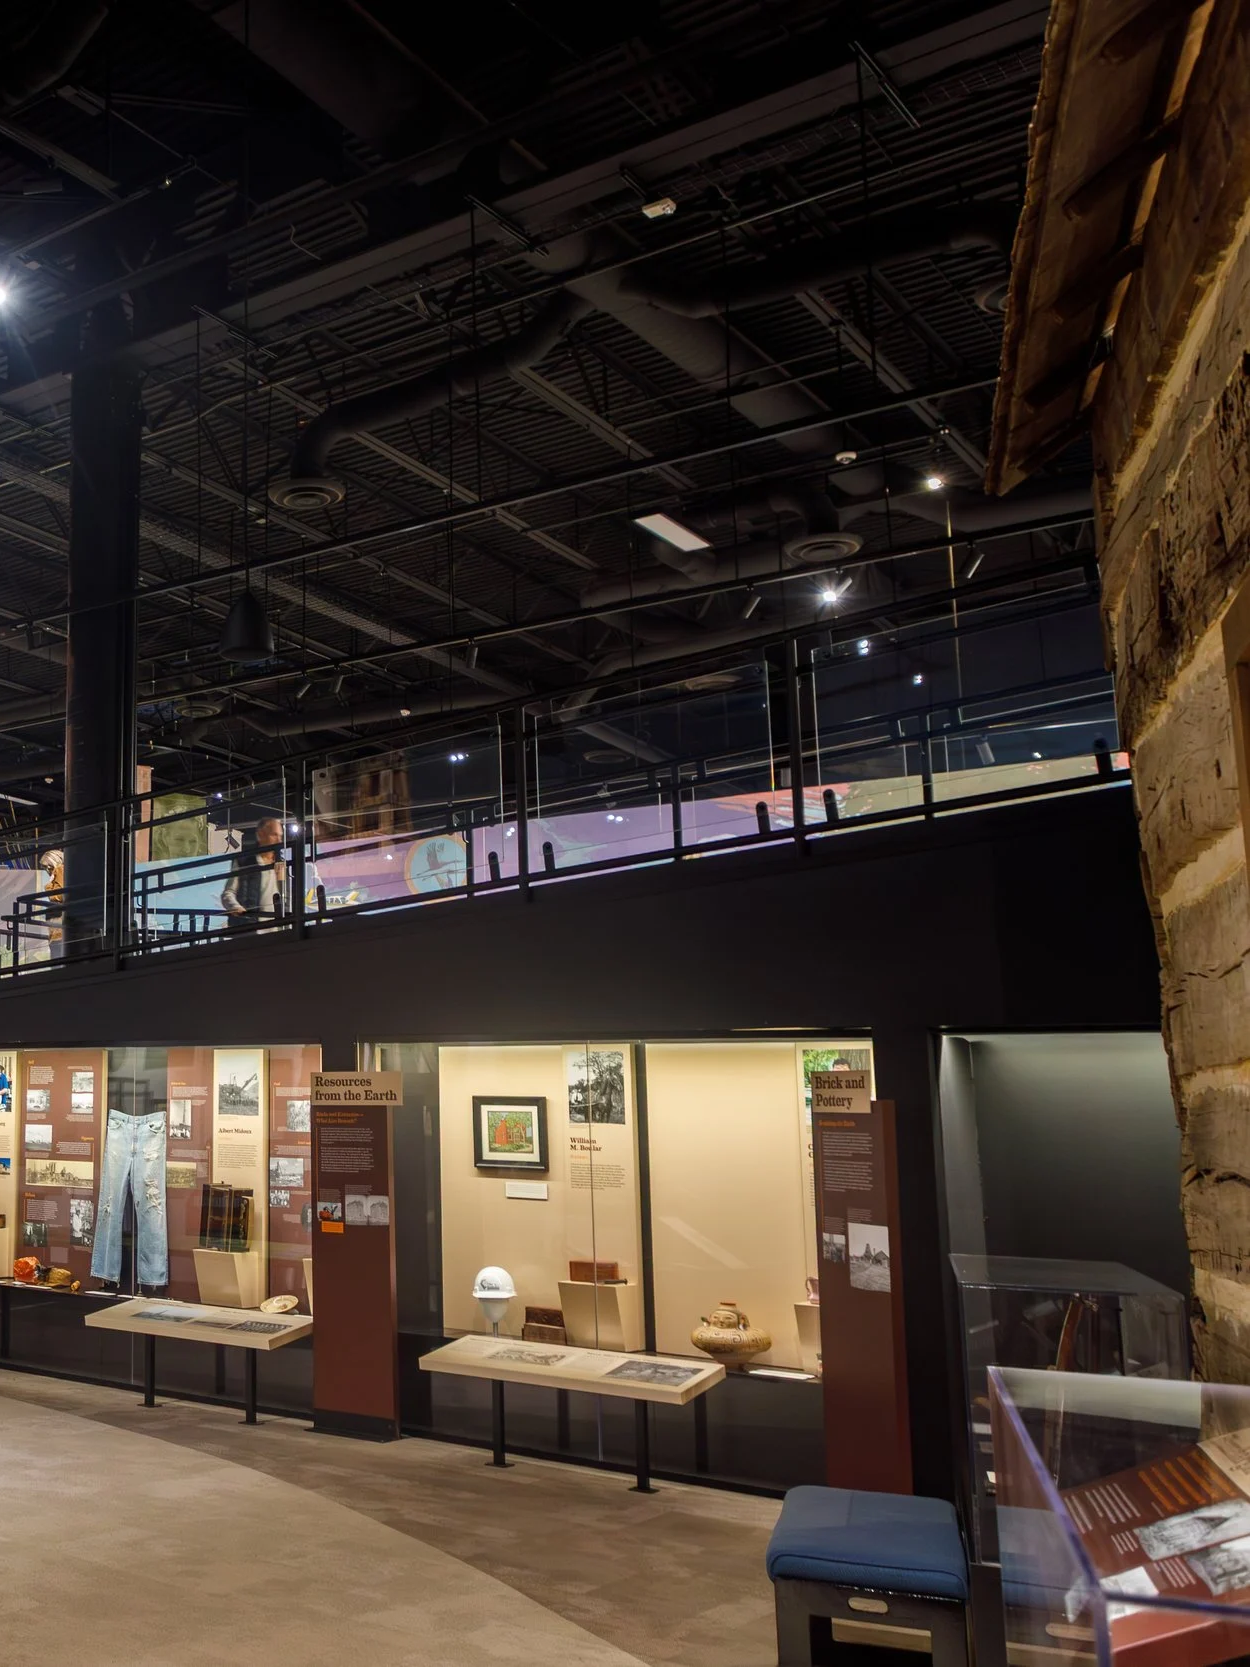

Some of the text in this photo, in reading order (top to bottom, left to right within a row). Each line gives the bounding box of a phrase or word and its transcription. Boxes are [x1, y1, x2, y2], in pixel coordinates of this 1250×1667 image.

[314, 1076, 372, 1087] Resources
[815, 1075, 865, 1090] Brick and
[314, 1089, 398, 1101] from the Earth
[815, 1094, 854, 1110] Pottery
